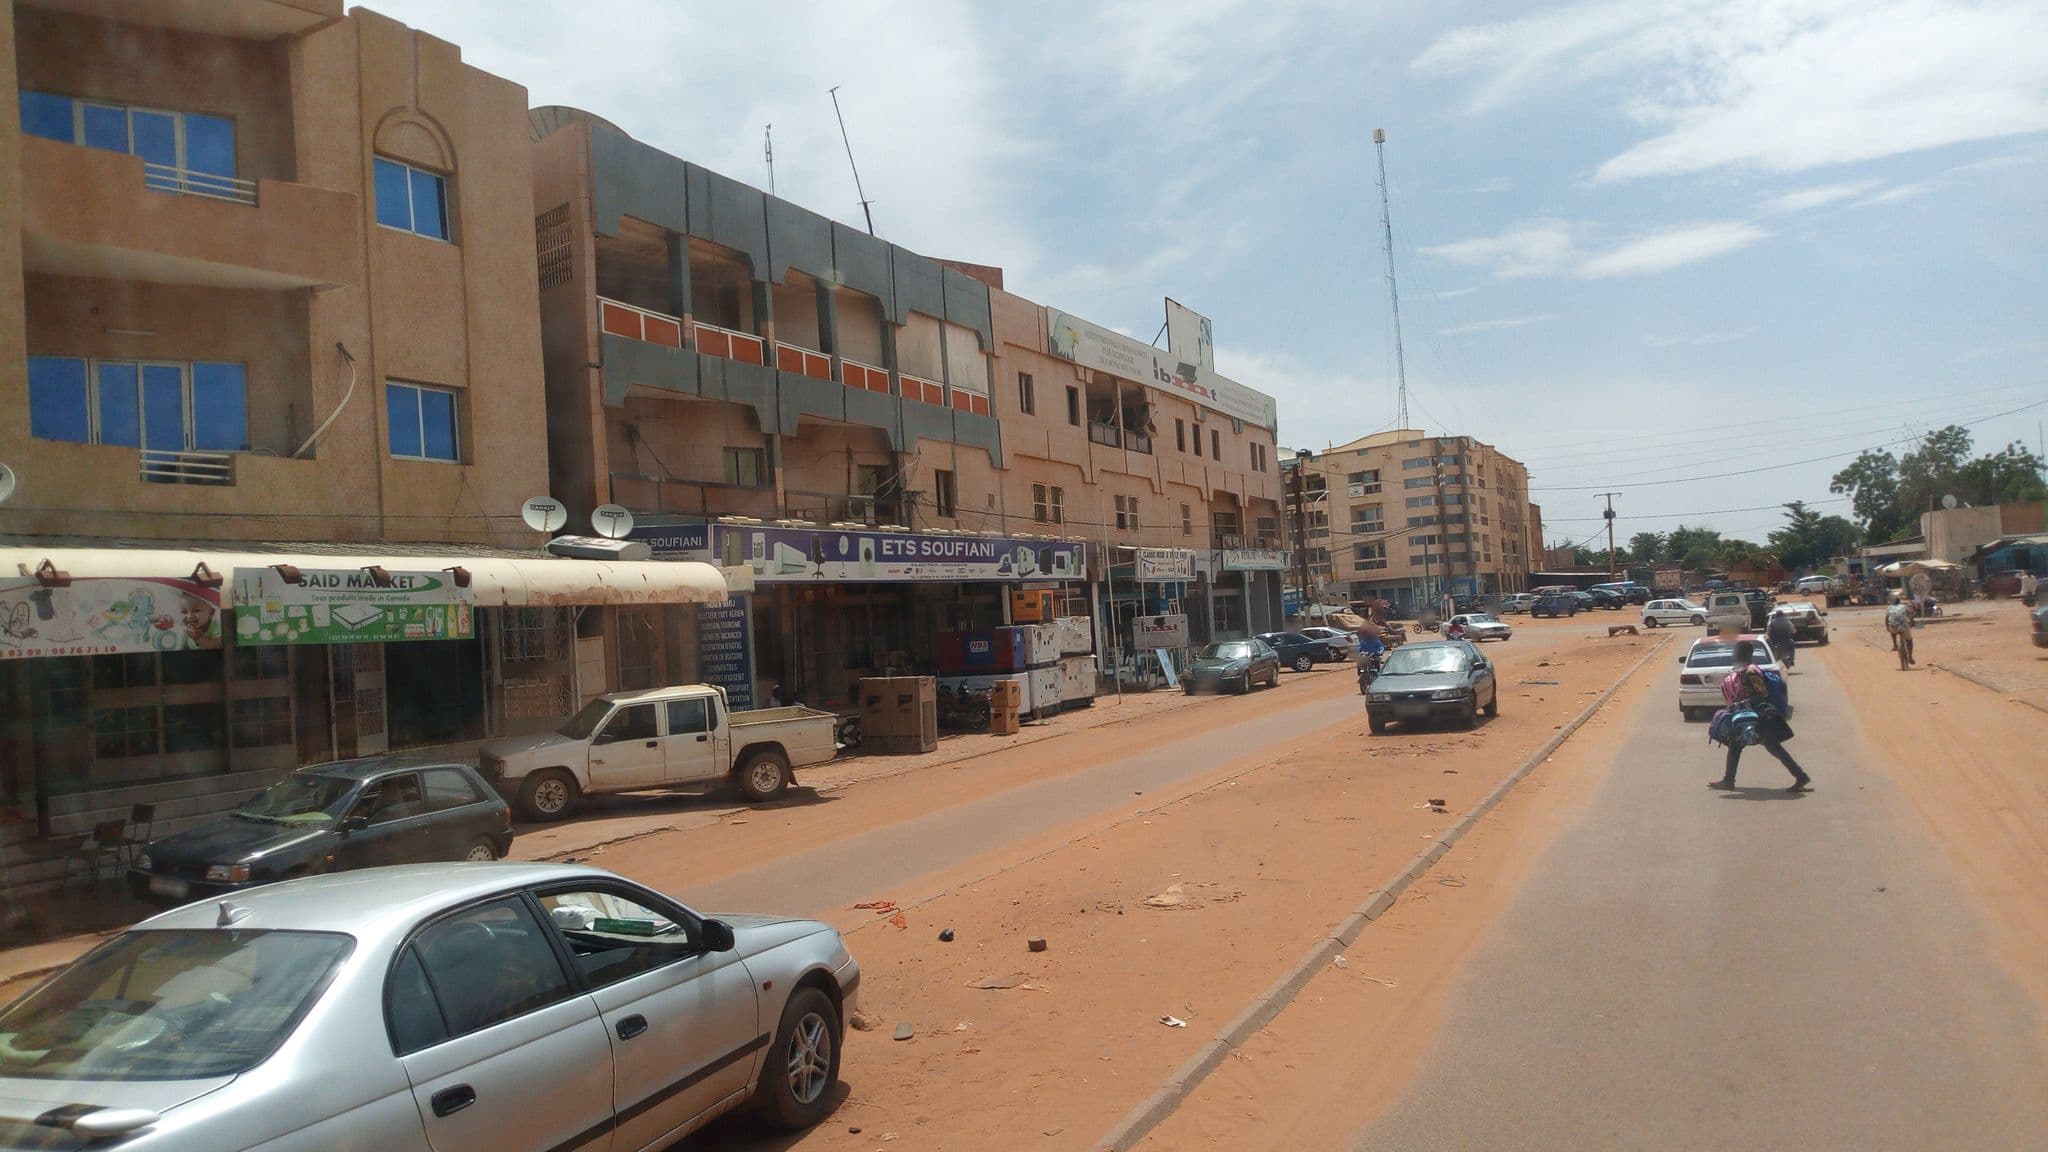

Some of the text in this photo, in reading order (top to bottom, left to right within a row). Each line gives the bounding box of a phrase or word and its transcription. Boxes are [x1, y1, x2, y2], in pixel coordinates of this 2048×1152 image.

[650, 536, 702, 548] SOUFIANI
[882, 539, 995, 557] ETS SOUFIANI
[298, 573, 340, 588] SAID
